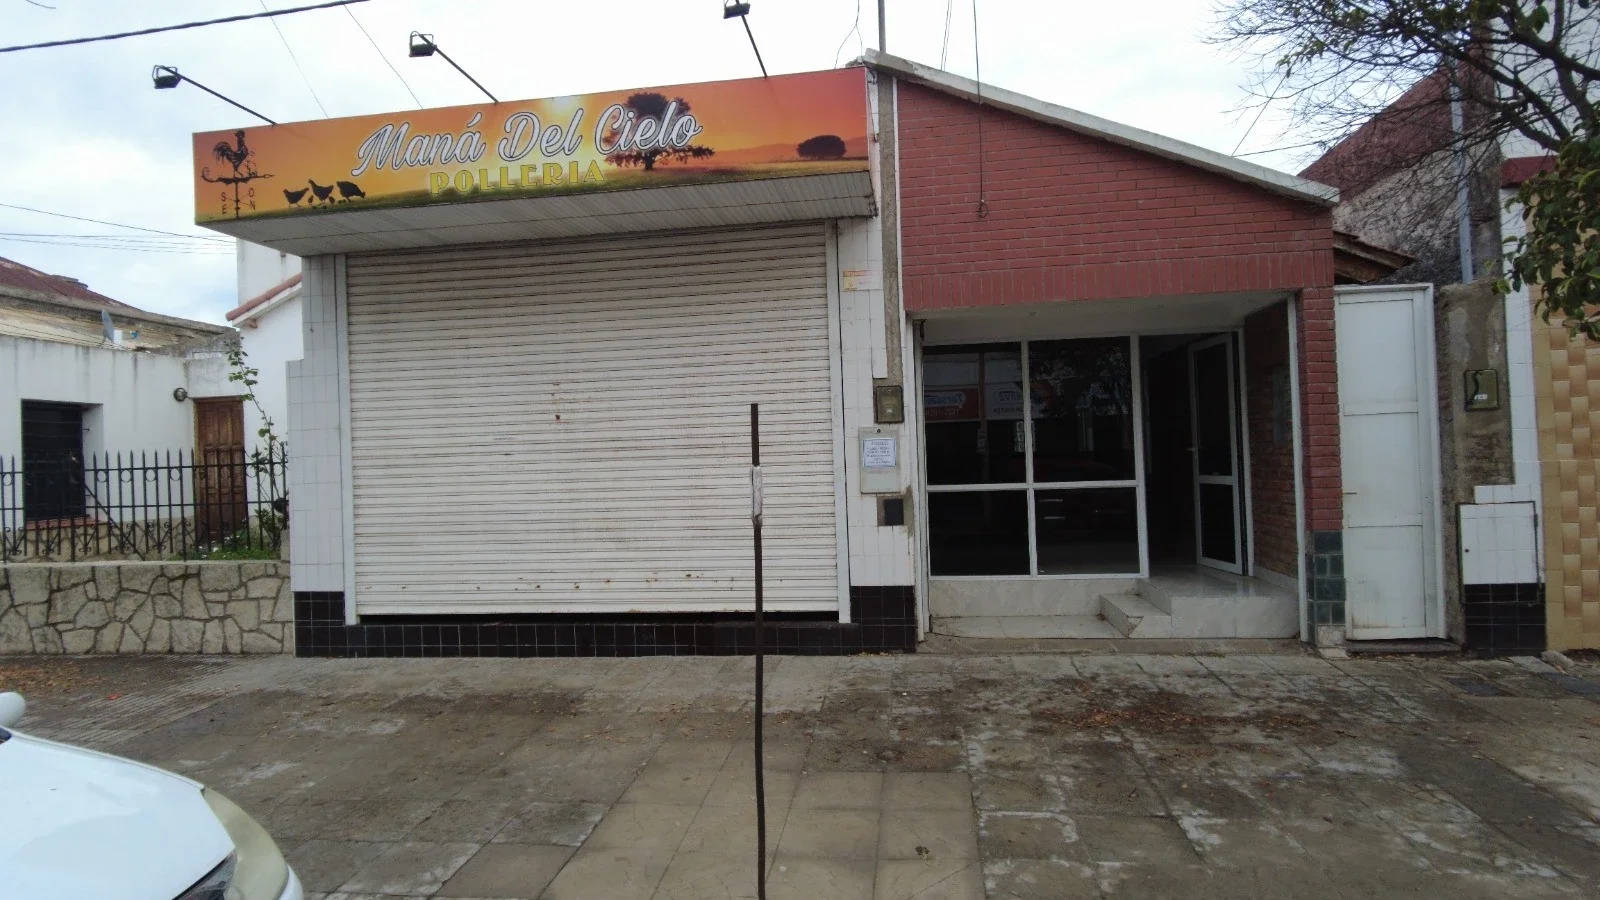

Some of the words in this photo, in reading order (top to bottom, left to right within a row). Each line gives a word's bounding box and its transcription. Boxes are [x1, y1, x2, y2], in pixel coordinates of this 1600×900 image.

[351, 112, 486, 176] Maná
[498, 108, 584, 161] Del
[595, 101, 703, 155] Cielo
[430, 160, 604, 195] POLLERIA
